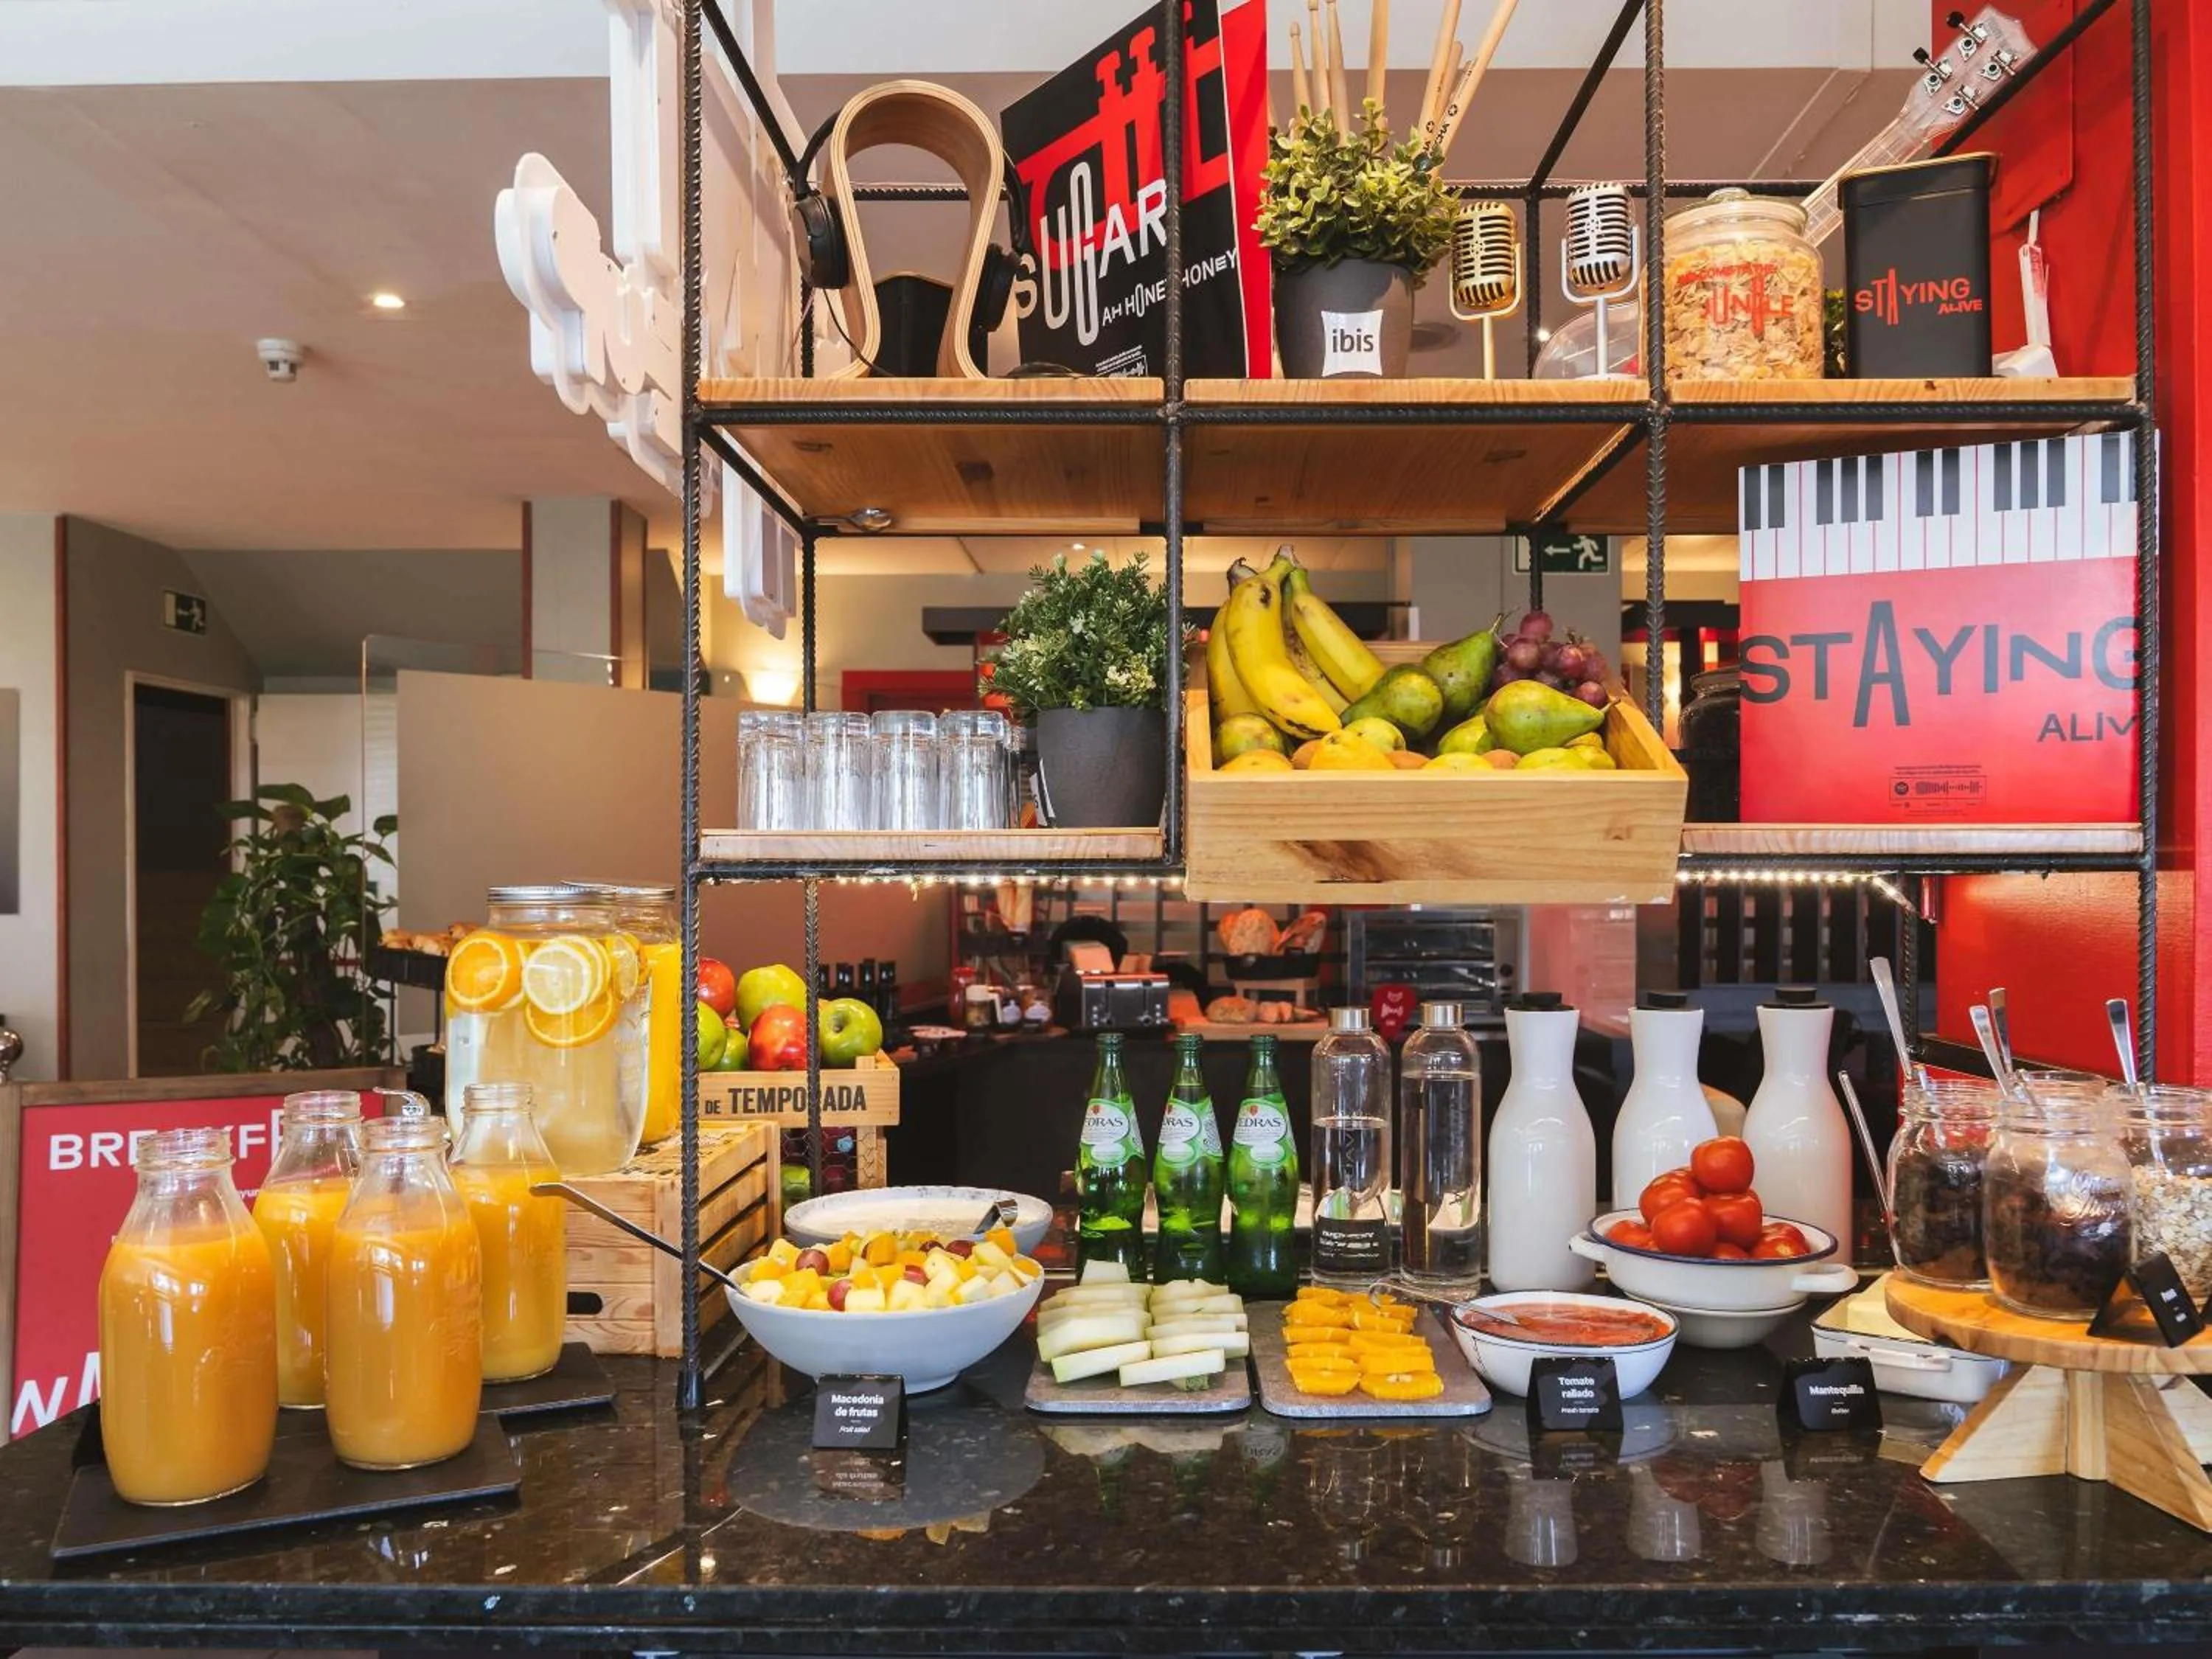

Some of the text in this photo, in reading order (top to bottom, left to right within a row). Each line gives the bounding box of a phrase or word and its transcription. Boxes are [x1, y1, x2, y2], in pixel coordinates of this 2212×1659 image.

[1102, 303, 1122, 327] AH
[1124, 278, 1167, 318] HONE
[1854, 268, 1971, 325] STAYING
[1937, 299, 1983, 315] ALIVE
[1332, 327, 1374, 353] ibis
[2037, 712, 2138, 742] ALIV
[705, 1085, 866, 1115] DE TEMPOADA
[831, 1394, 885, 1405] Macedonia
[835, 1407, 878, 1418] de frutas
